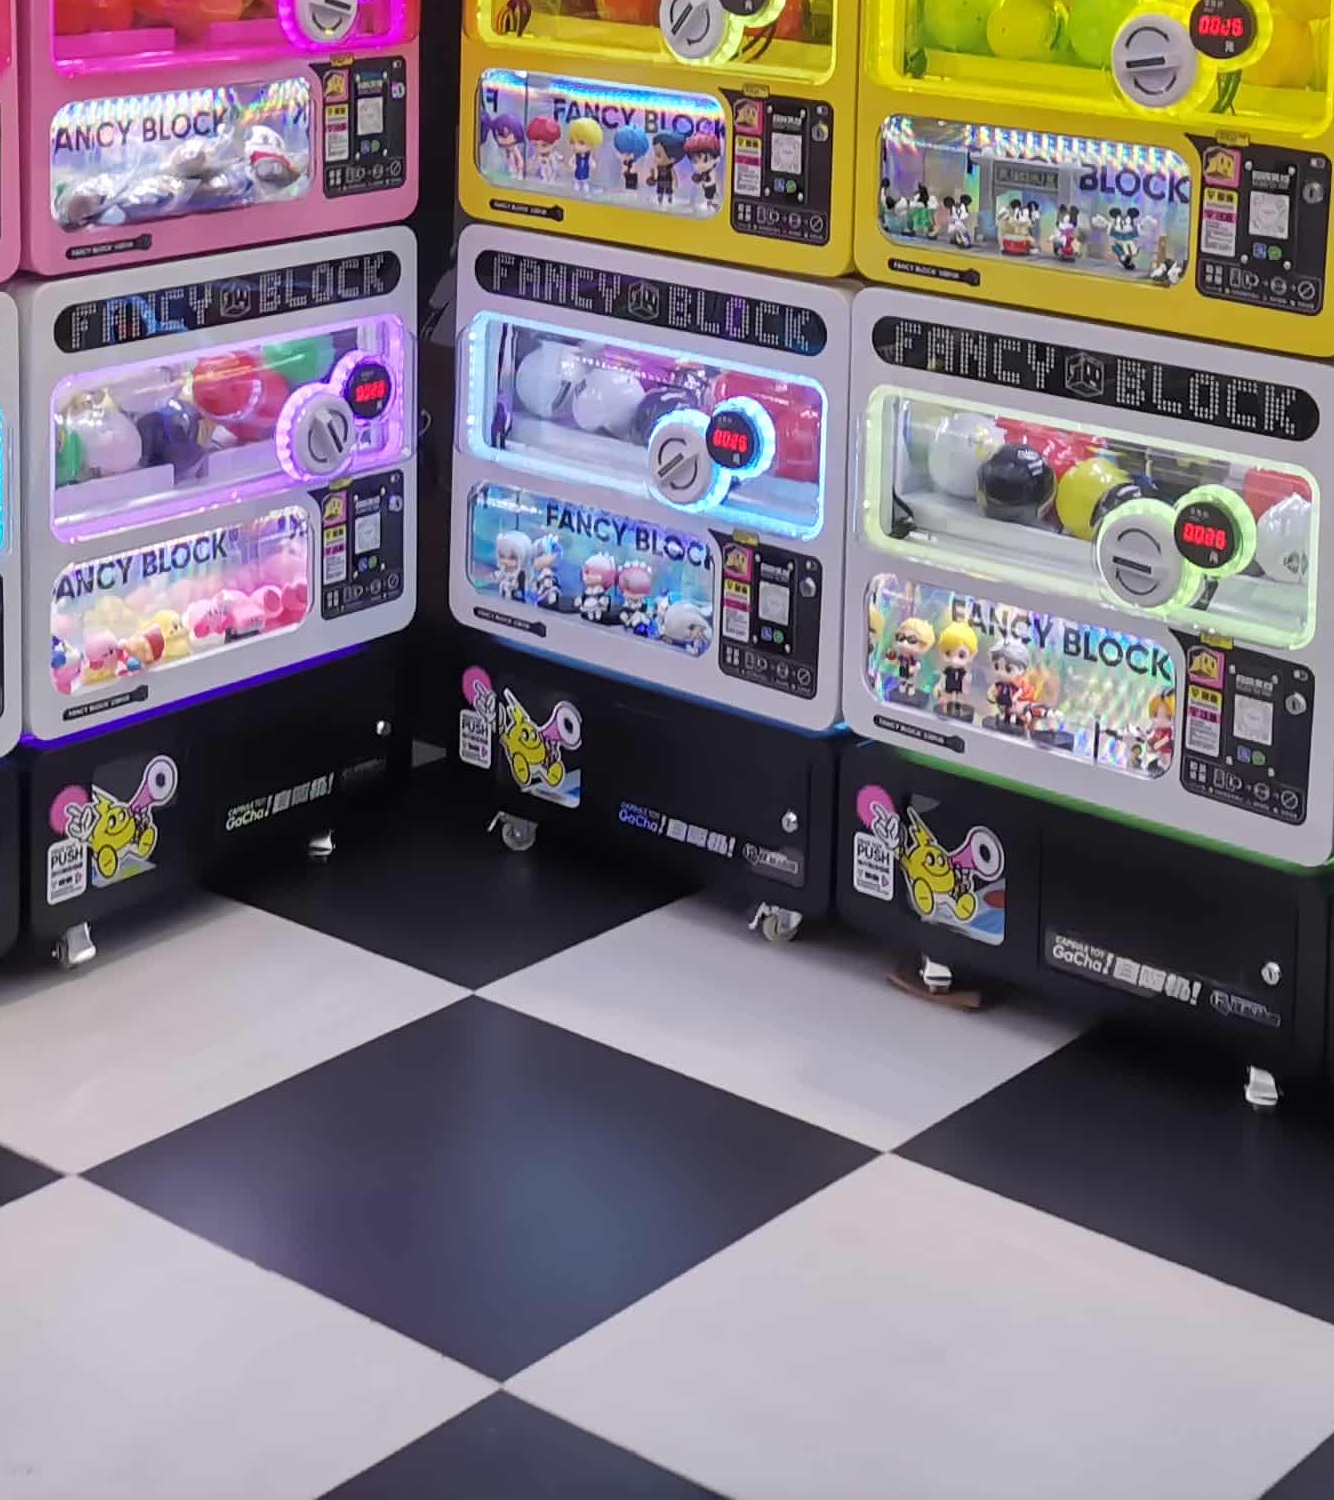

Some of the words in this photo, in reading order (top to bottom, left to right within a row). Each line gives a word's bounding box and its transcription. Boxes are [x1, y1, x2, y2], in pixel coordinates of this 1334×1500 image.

[71, 290, 212, 350] FANCY
[259, 255, 383, 313] BLOCK
[494, 253, 621, 313] FANCY
[669, 284, 810, 351] BLOCK
[895, 321, 1055, 389] FANCY
[1116, 360, 1296, 434] BLOCK
[545, 502, 626, 545] FANCY
[142, 531, 229, 577] BLOCK
[1063, 627, 1173, 681] BLOCK
[460, 719, 489, 737] PUSH
[50, 848, 84, 870] PUSH
[857, 844, 891, 866] PUSH
